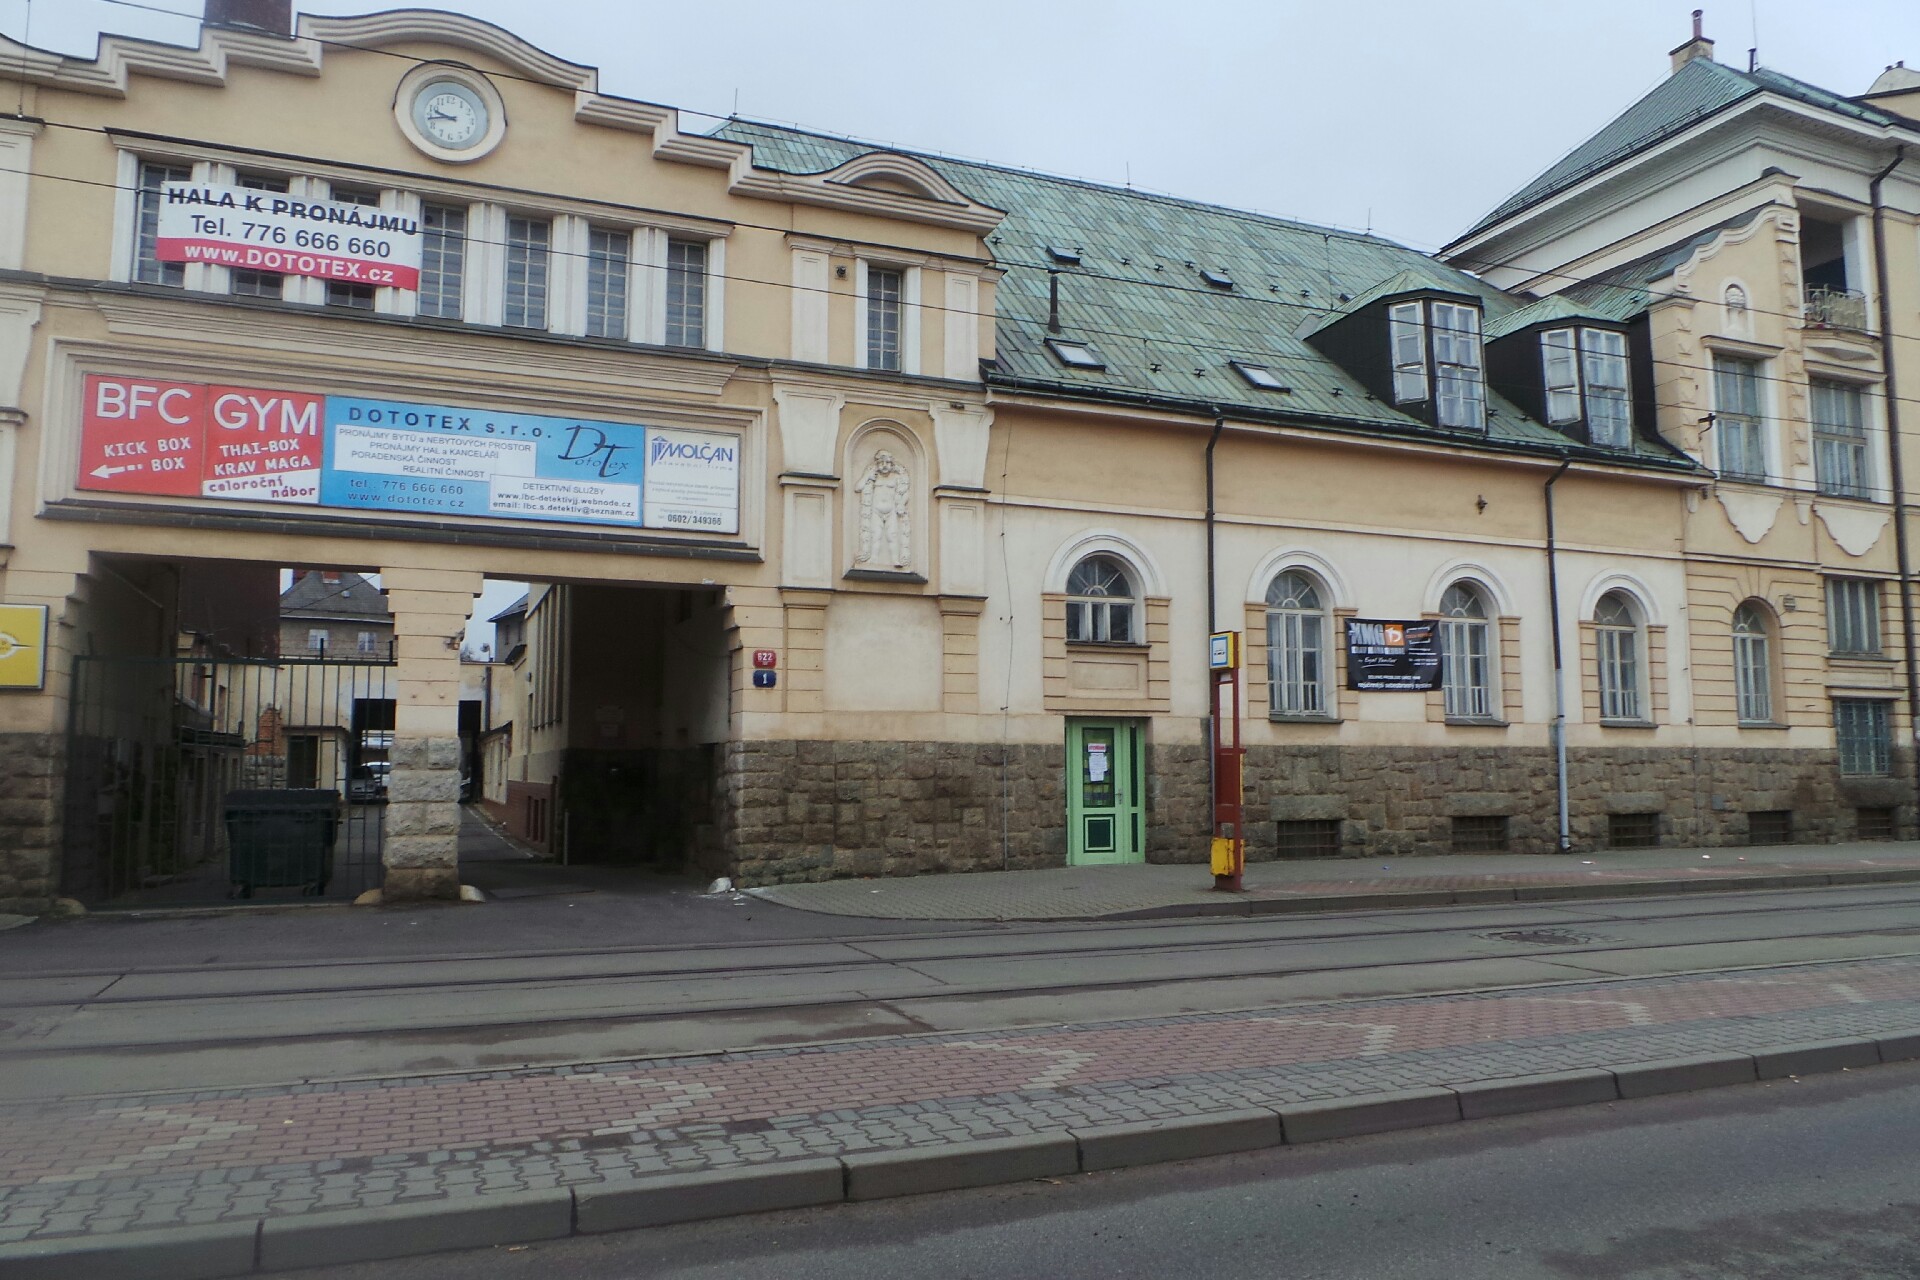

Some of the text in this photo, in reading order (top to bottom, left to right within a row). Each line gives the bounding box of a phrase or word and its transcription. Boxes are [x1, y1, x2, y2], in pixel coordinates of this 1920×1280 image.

[168, 187, 417, 236] HALA K PRONÁJMU
[191, 214, 391, 258] Tel. 776 666 660
[184, 245, 394, 283] www.DOTOTEX.cz
[96, 382, 193, 425] BFC
[213, 393, 318, 436] GYM
[348, 407, 552, 439] DOTOTEX s.r.o.
[104, 436, 192, 458] KICK BOX
[219, 438, 300, 458] THAI-BOX
[339, 428, 390, 439] PRONÁJMY
[488, 441, 532, 452] PROSTOR
[369, 441, 421, 453] PRONÁJMY
[423, 447, 442, 455] HAL
[351, 450, 457, 467] PORADENSKÁ ČINNOST
[660, 442, 733, 464] MOLČAN
[151, 456, 186, 472] BOX
[214, 454, 312, 476] KRAV MAGA
[445, 467, 485, 479] ČINNOST
[208, 475, 284, 494] celoroční
[271, 485, 316, 499] nábor
[382, 480, 407, 491] 776
[412, 482, 436, 493] 666
[440, 485, 464, 495] 660
[522, 482, 606, 496] DETEKTIVNÍ SLUŽBY
[492, 501, 520, 509] email:
[762, 673, 768, 685] 1
